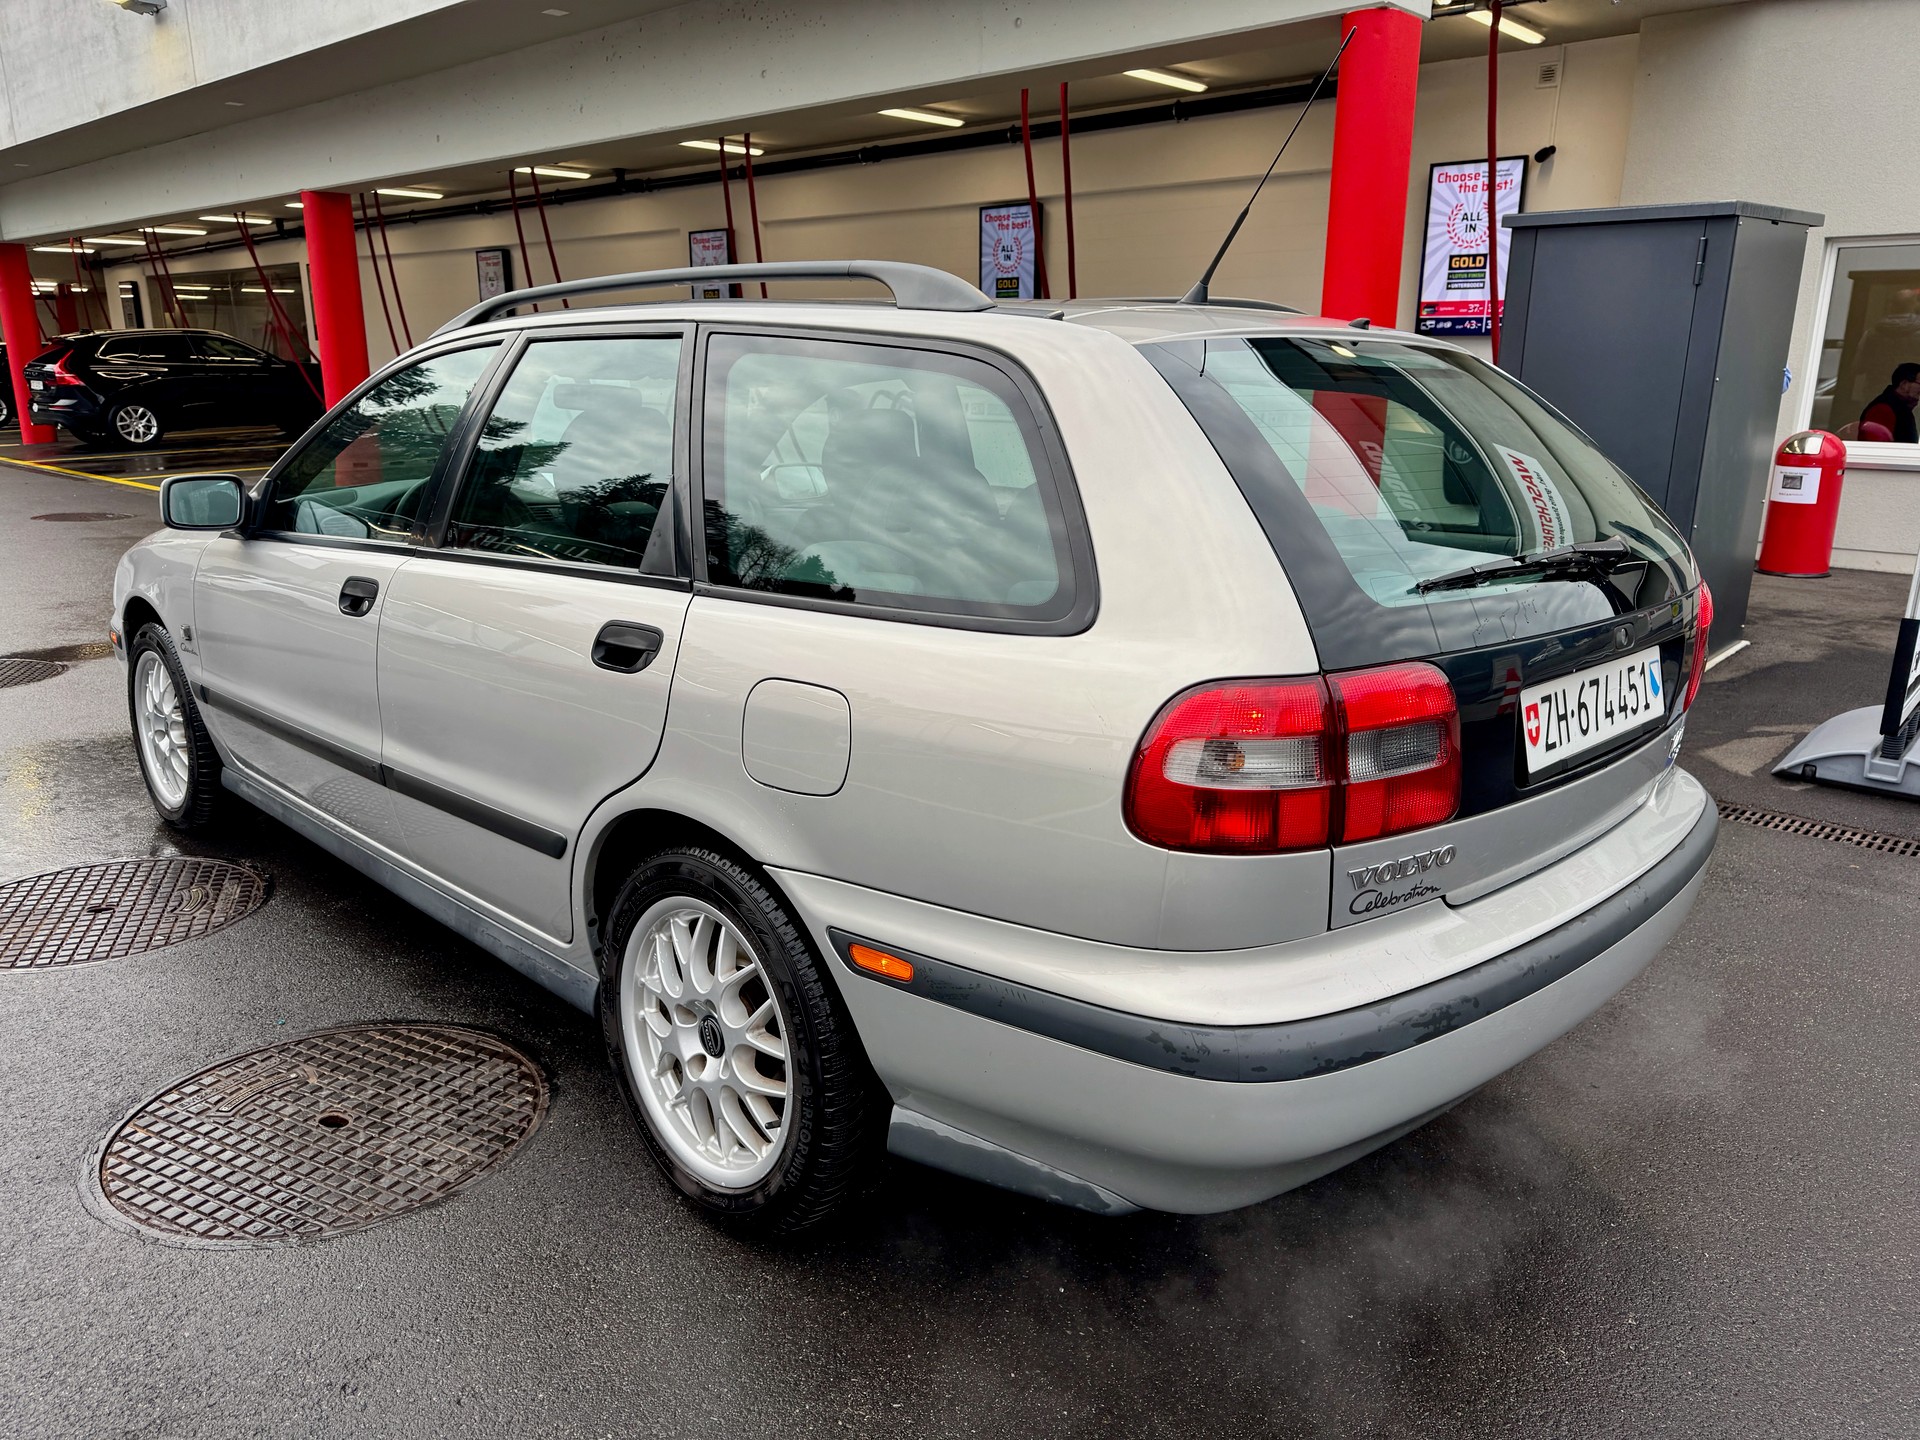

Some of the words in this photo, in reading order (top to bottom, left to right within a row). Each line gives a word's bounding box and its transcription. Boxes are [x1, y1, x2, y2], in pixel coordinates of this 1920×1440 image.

[1437, 172, 1481, 183] Choose
[1458, 182, 1478, 193] the
[1481, 179, 1513, 192] bst!
[985, 213, 1011, 222] Choose
[1461, 212, 1483, 222] ALL
[998, 222, 1010, 230] the
[1012, 220, 1031, 229] best!
[1465, 223, 1477, 233] IN
[1451, 256, 1485, 268] GOLD
[998, 280, 1017, 288] GOLD
[1347, 844, 1457, 890] VOLVO
[1349, 879, 1441, 915] Celebration
